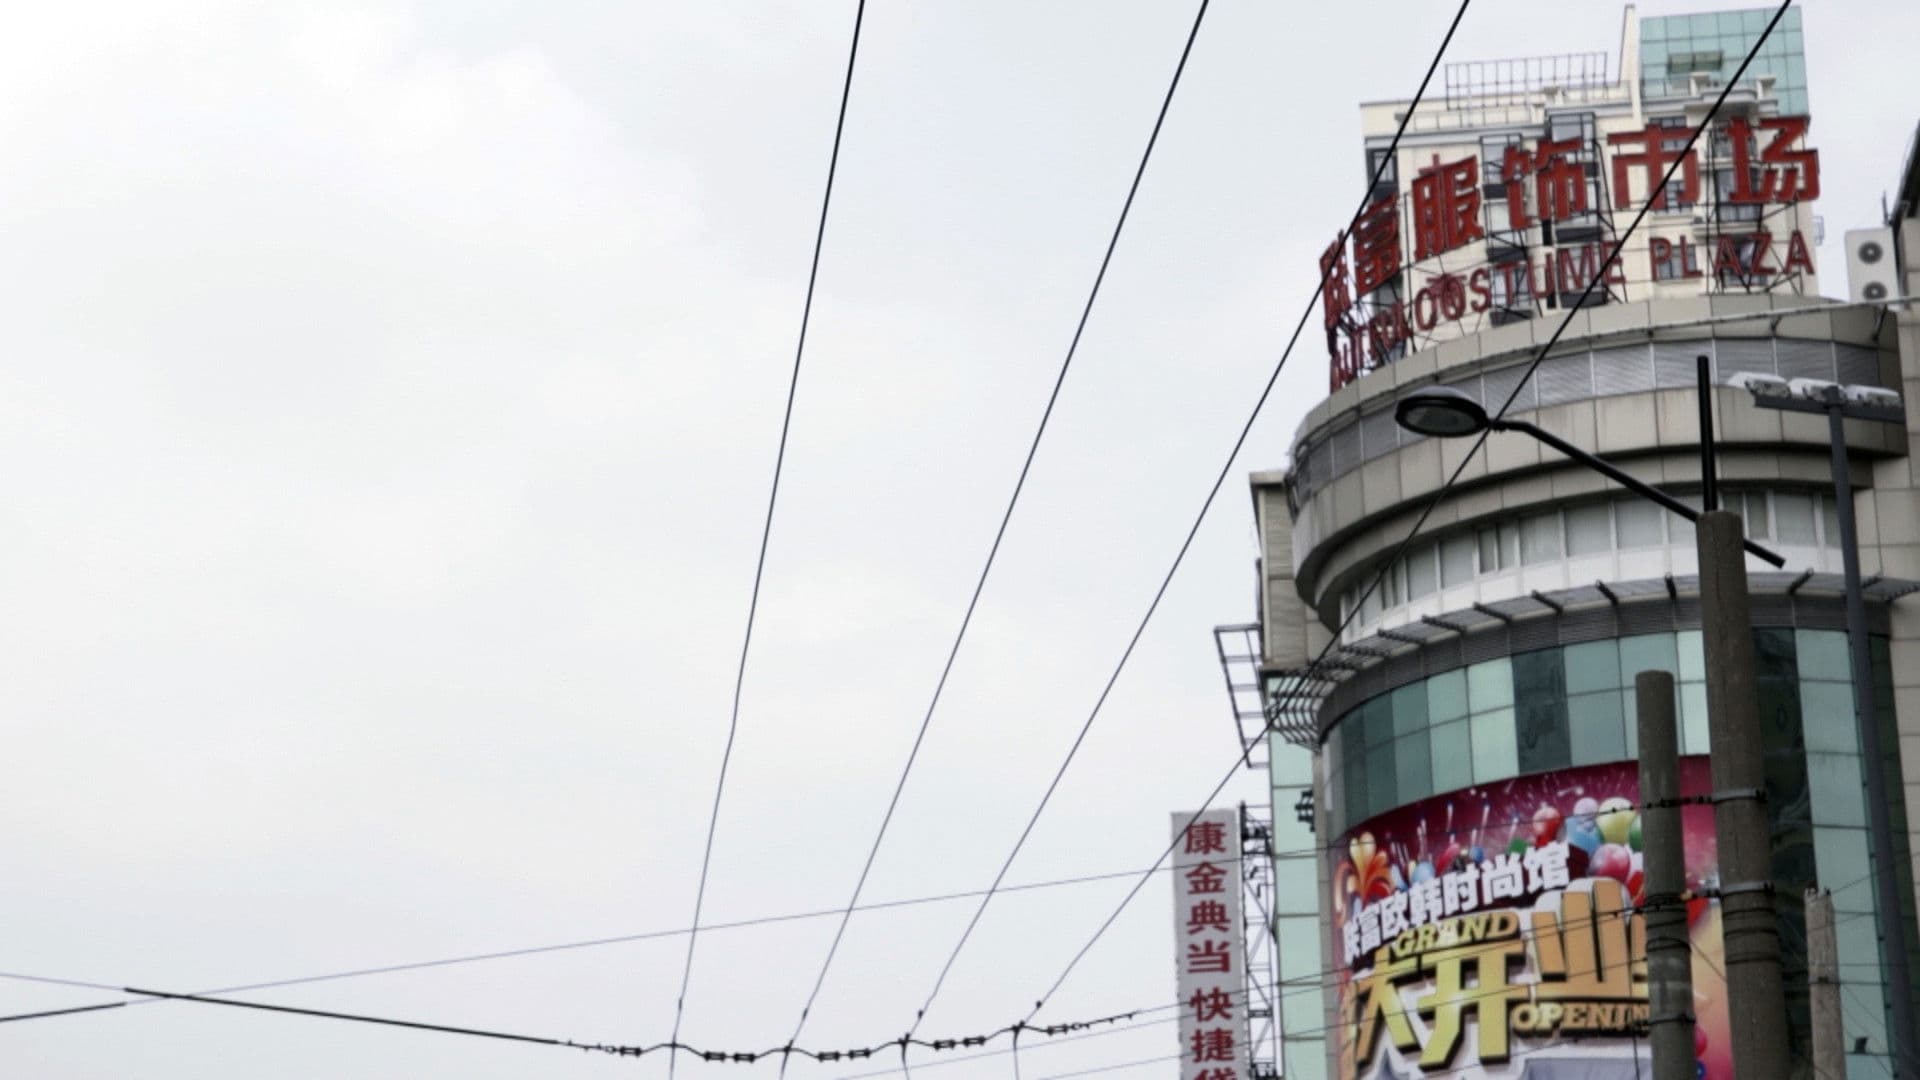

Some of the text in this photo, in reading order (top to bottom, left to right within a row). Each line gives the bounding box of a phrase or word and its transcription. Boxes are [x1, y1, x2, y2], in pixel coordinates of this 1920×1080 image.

[1650, 231, 1815, 283] PLAZA
[1395, 911, 1521, 957] GRAND
[1511, 1002, 1649, 1032] OPENIN
